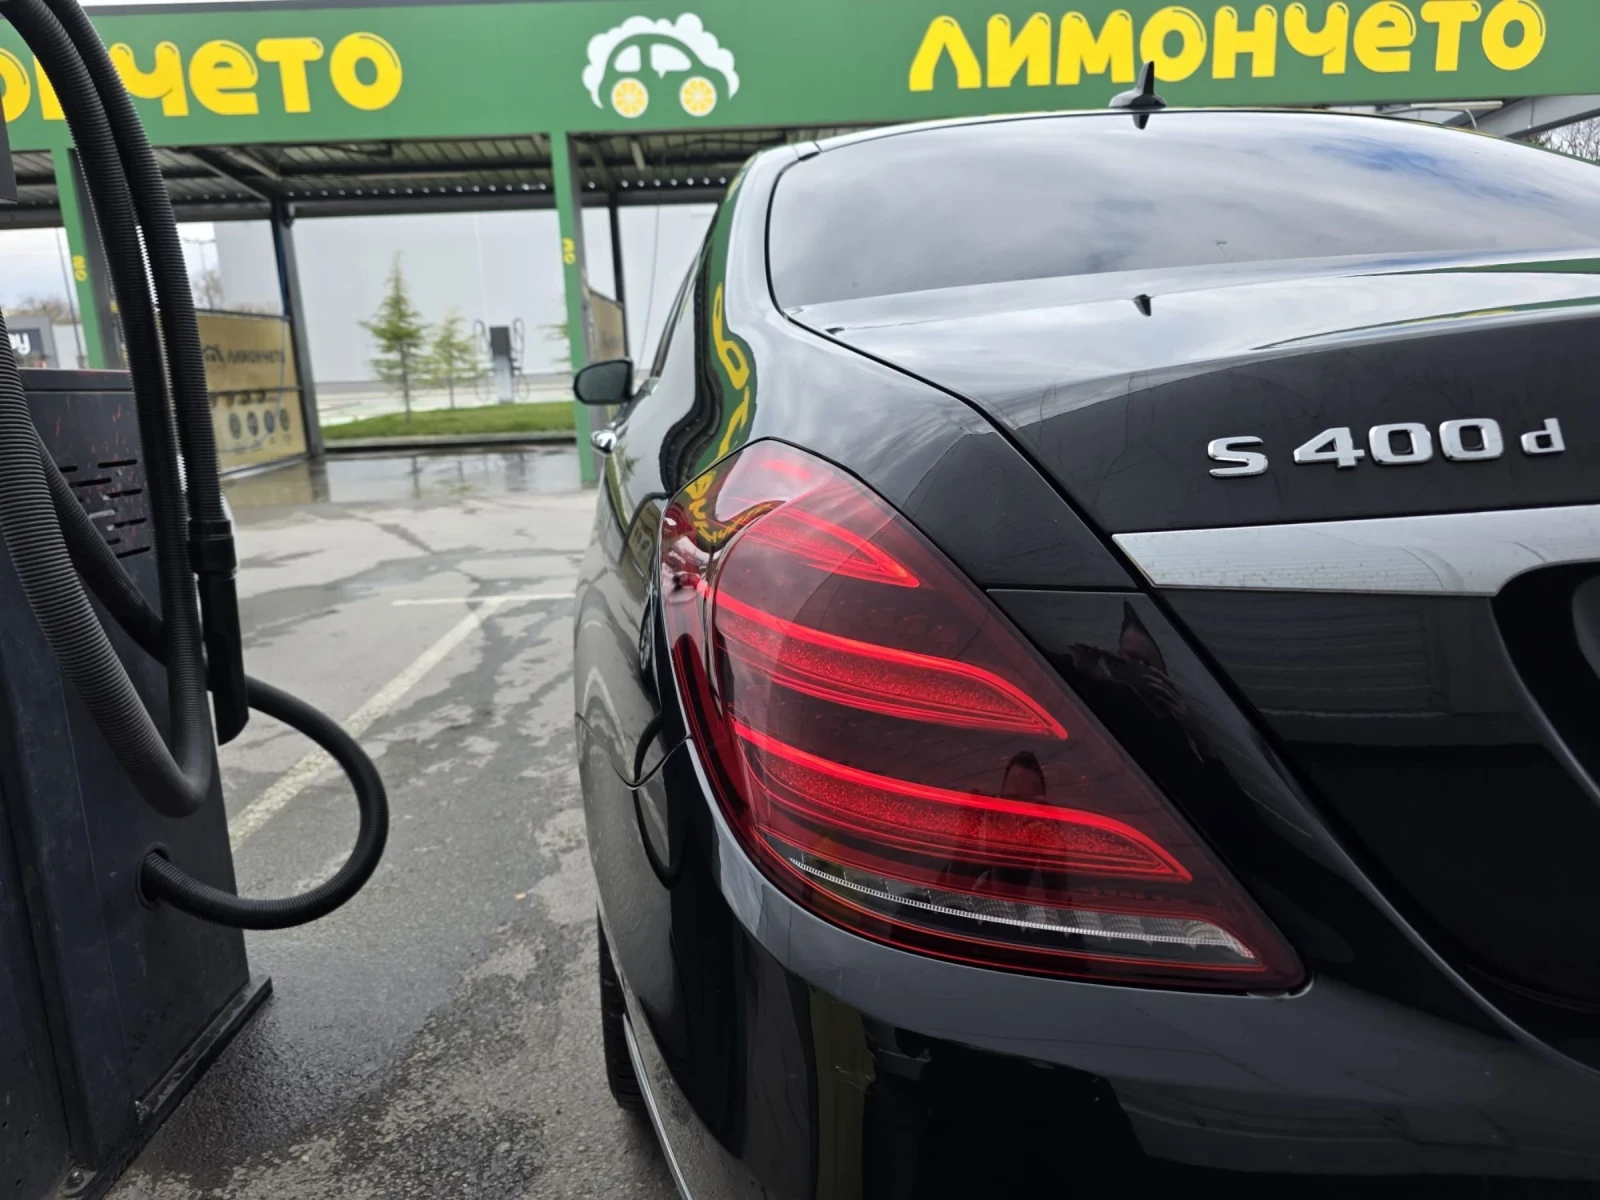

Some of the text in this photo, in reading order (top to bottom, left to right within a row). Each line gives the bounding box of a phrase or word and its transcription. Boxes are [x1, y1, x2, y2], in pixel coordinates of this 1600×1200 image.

[1207, 417, 1566, 478] S 400 d
